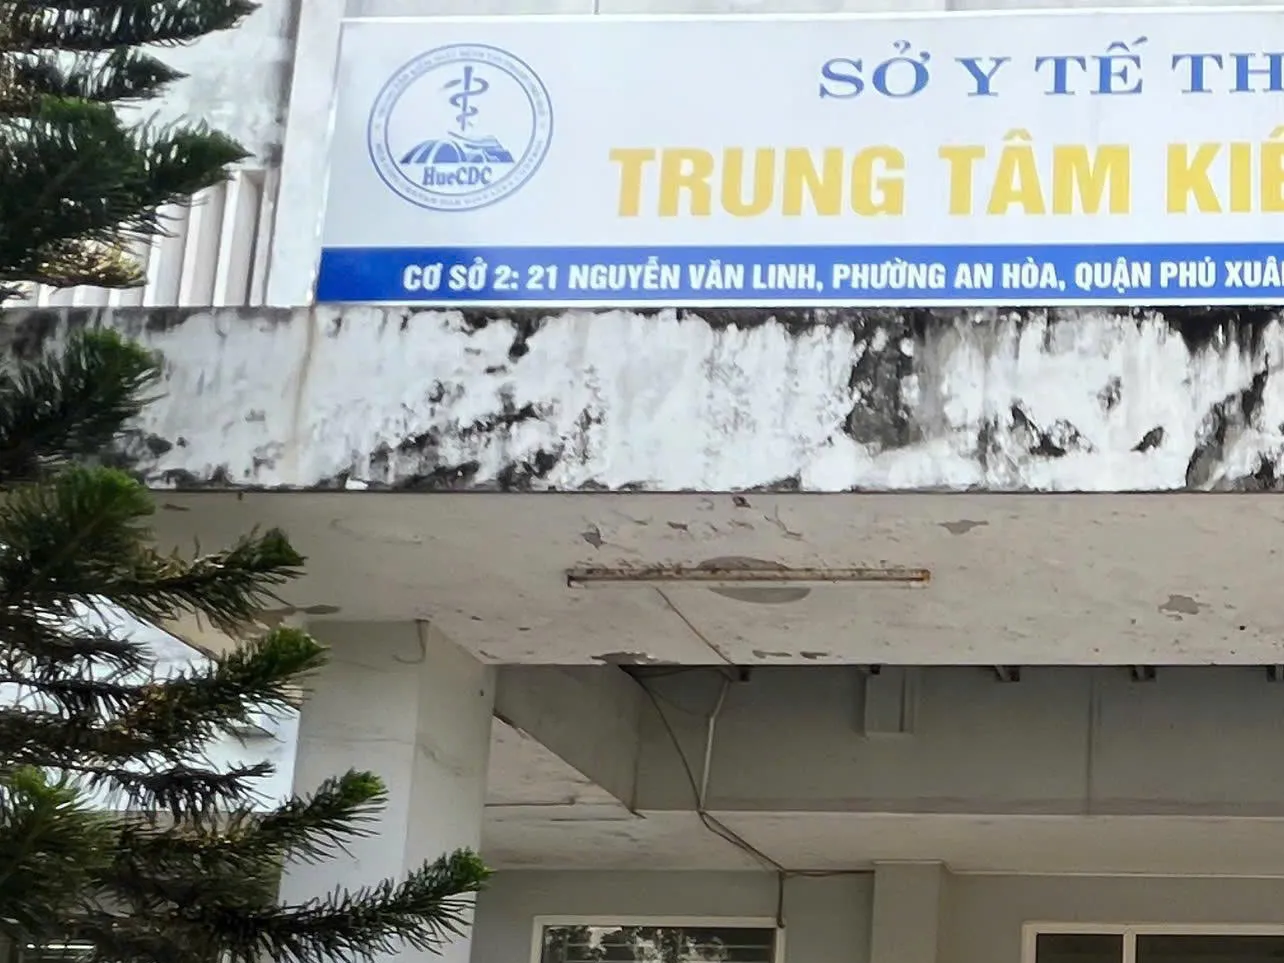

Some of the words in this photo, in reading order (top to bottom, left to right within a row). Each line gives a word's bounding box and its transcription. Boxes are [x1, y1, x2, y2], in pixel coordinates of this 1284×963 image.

[819, 40, 931, 99] SỞ
[955, 57, 1012, 97] Y
[1035, 36, 1148, 96] TẾ
[421, 166, 493, 187] HueCDC
[609, 146, 905, 218] TRUNG
[938, 128, 1131, 215] TÂM
[403, 263, 443, 290] CƠ
[448, 256, 489, 290] SỞ
[493, 265, 519, 290] 2:
[526, 265, 558, 290] 21
[568, 255, 681, 290] NGUYỄN
[688, 259, 745, 290] VĂN
[752, 263, 824, 292] LINH,
[832, 257, 946, 289] PHƯỜNG
[954, 263, 994, 289] AN
[1002, 257, 1067, 292] HÒA,
[1075, 256, 1152, 294] QUẬN
